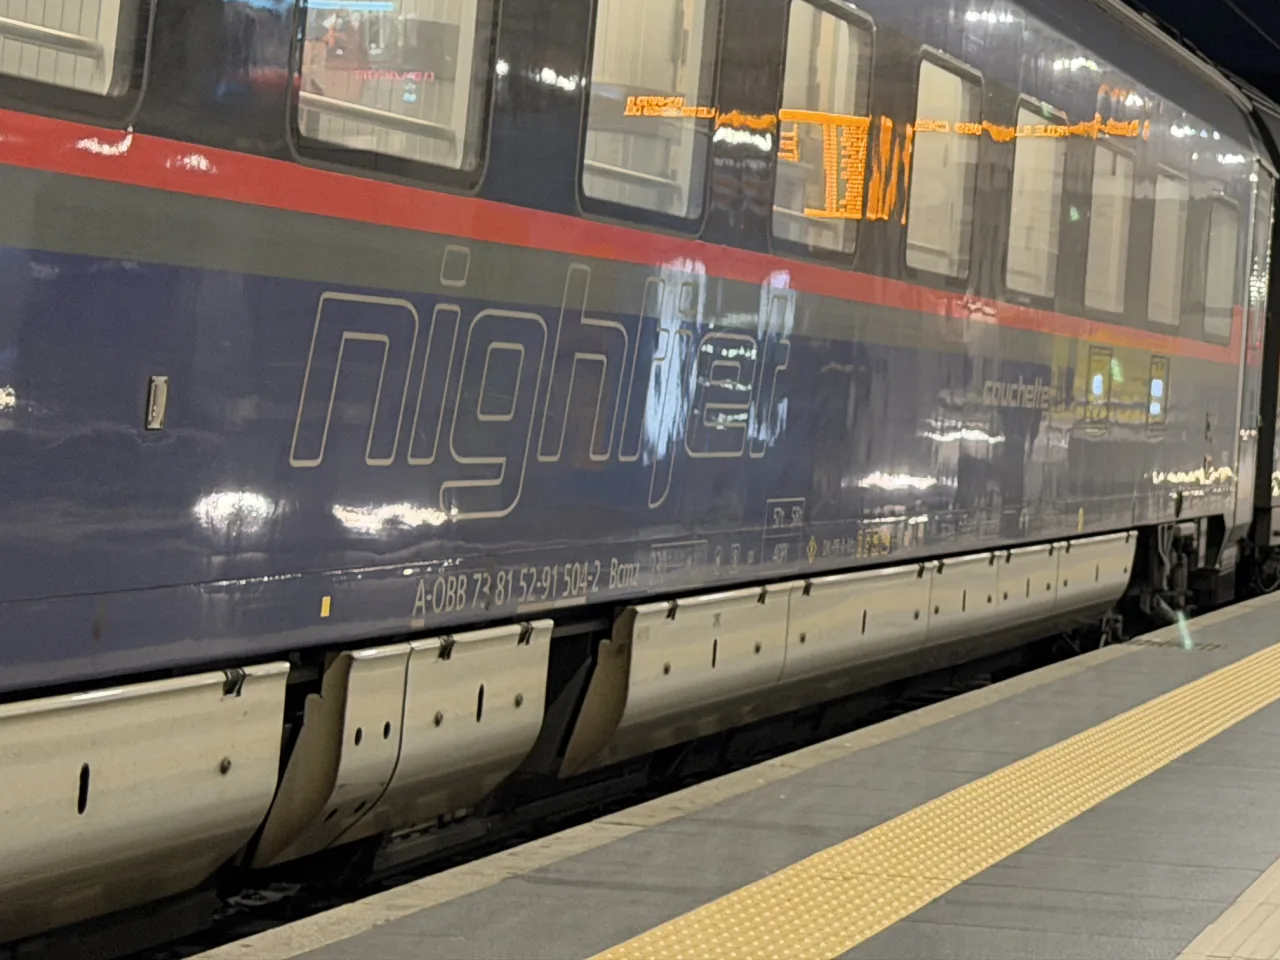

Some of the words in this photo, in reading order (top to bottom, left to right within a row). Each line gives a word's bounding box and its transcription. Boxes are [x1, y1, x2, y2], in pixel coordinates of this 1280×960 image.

[289, 245, 790, 521] nightjet
[983, 376, 1050, 408] couchette
[471, 573, 491, 609] 73
[495, 570, 513, 606] 81
[518, 565, 557, 602] 52-91
[562, 560, 600, 598] 504-2
[609, 558, 640, 589] Bcmz
